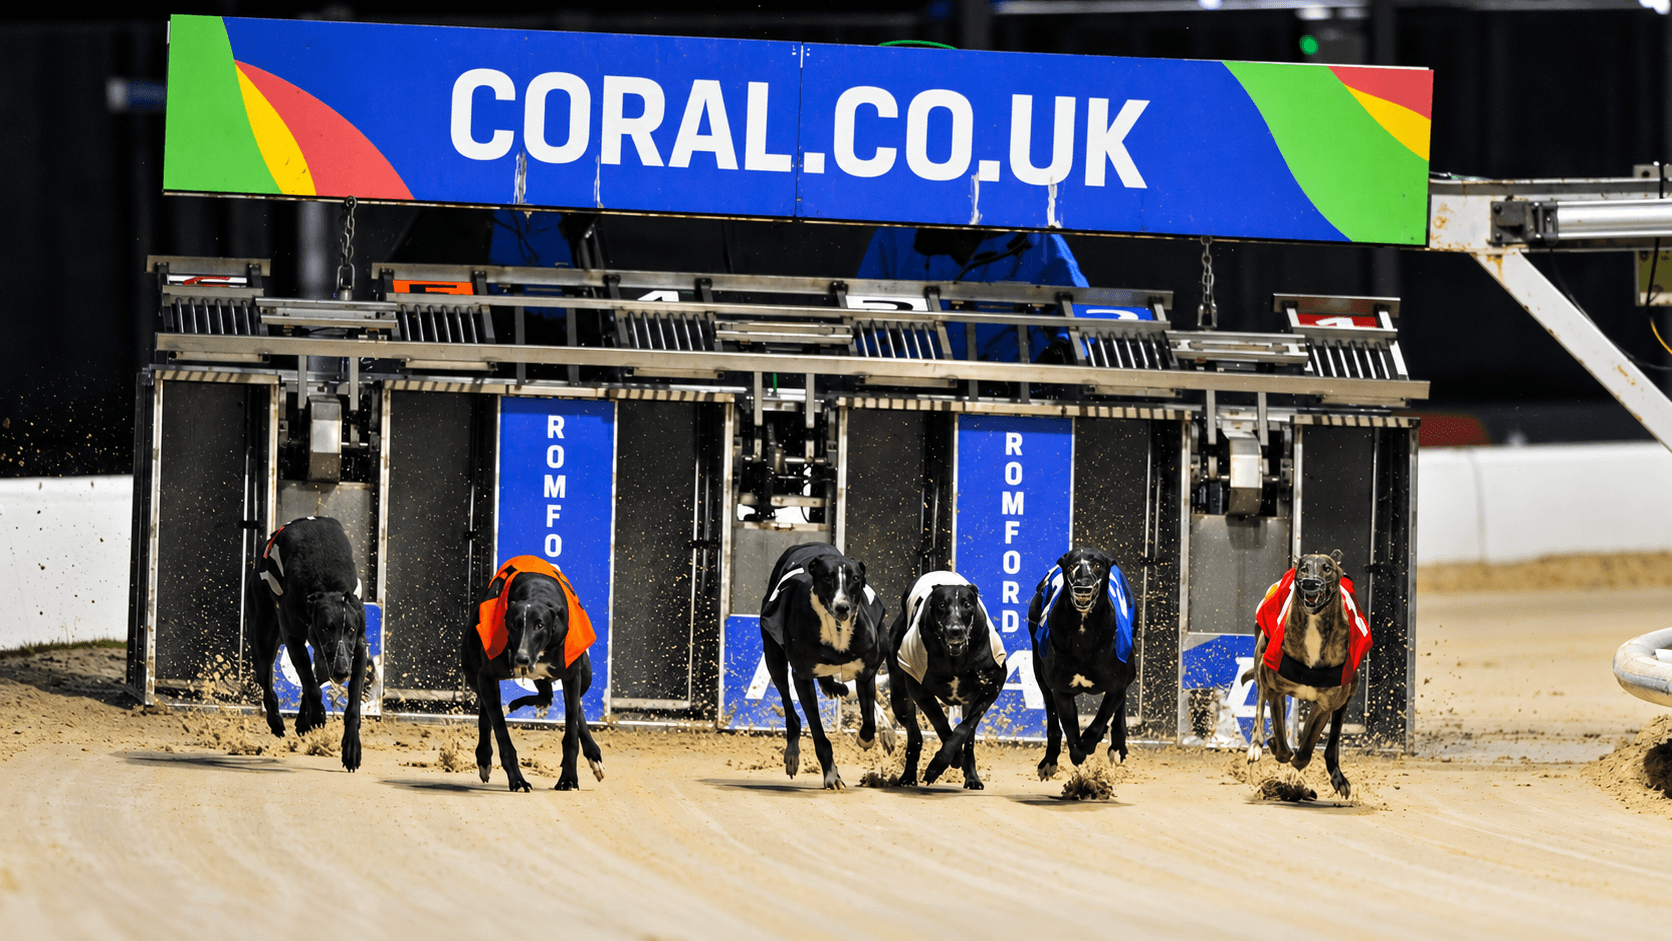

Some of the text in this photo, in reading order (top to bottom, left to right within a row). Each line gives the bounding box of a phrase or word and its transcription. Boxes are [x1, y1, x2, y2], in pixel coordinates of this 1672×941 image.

[450, 68, 1149, 189] CORAL.CO.UK
[543, 415, 566, 573] ROMFO
[1001, 432, 1024, 633] ROMFORD
